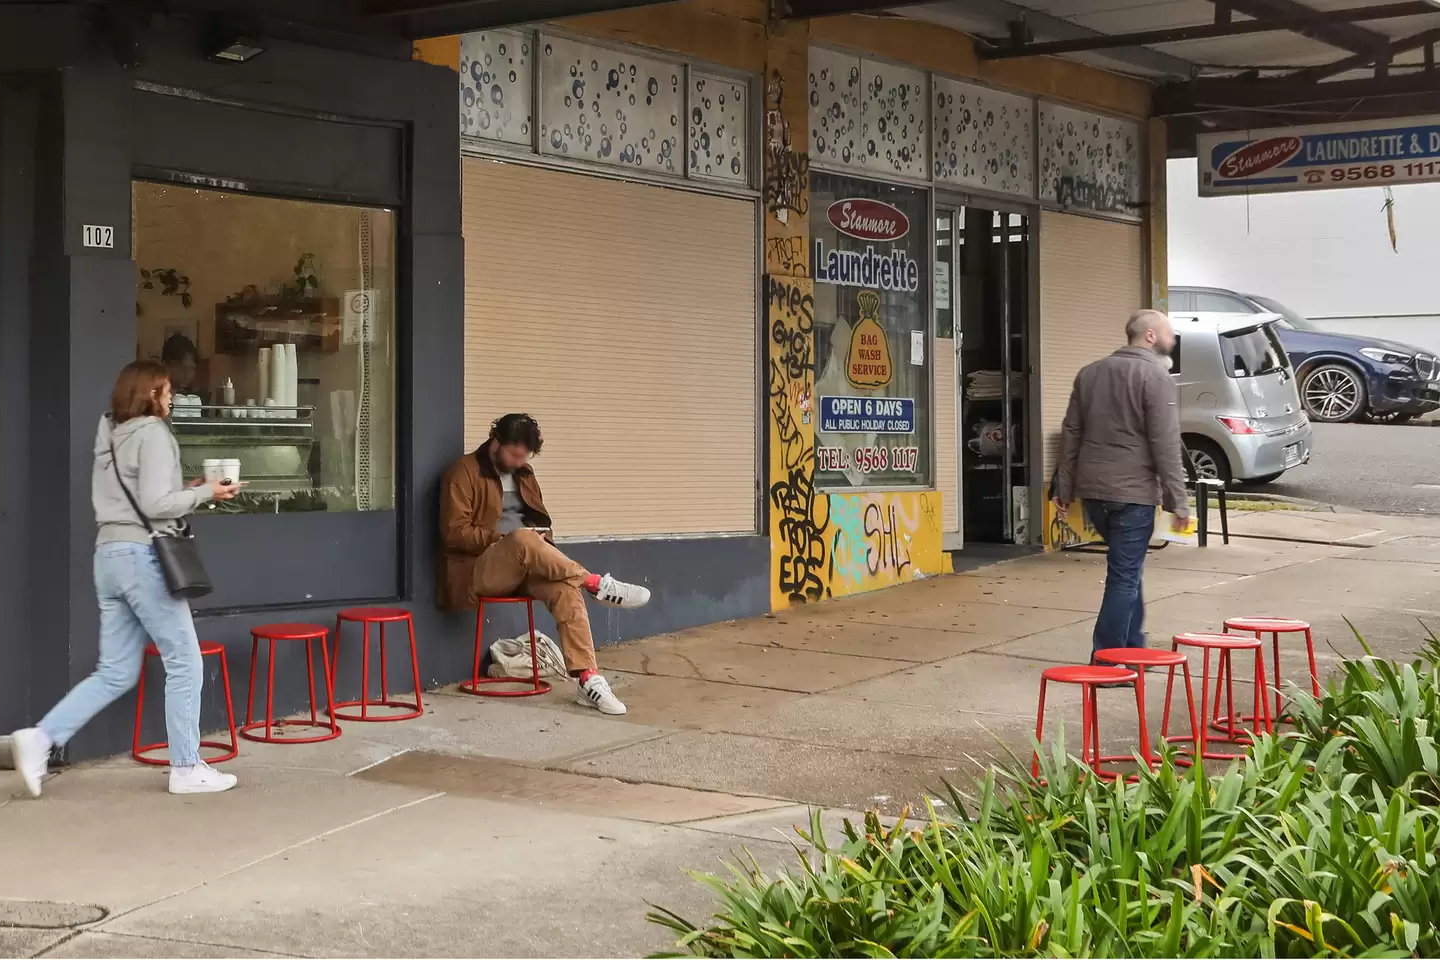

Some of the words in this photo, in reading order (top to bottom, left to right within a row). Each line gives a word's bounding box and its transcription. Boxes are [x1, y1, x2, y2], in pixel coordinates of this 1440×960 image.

[1306, 135, 1405, 162] LAUNDRETTE
[1410, 133, 1424, 154] &
[1227, 139, 1297, 176] Stanmore
[1330, 164, 1395, 181] 9568
[840, 202, 897, 235] Stanmore
[86, 226, 112, 246] 102
[815, 238, 918, 292] Laundrette
[860, 334, 878, 346] BAG
[858, 348, 882, 361] WASH
[852, 364, 887, 376] SERVICE
[831, 398, 862, 415] OPEN
[865, 399, 873, 416] 6
[875, 400, 903, 417] DAYS
[825, 419, 837, 430] ALL
[838, 419, 860, 430] PUBLIC
[861, 419, 886, 431] HOLIDAY
[887, 420, 910, 431] CLOSED
[817, 446, 851, 471] TEL:
[855, 447, 888, 473] 9568
[892, 447, 918, 473] 1117
